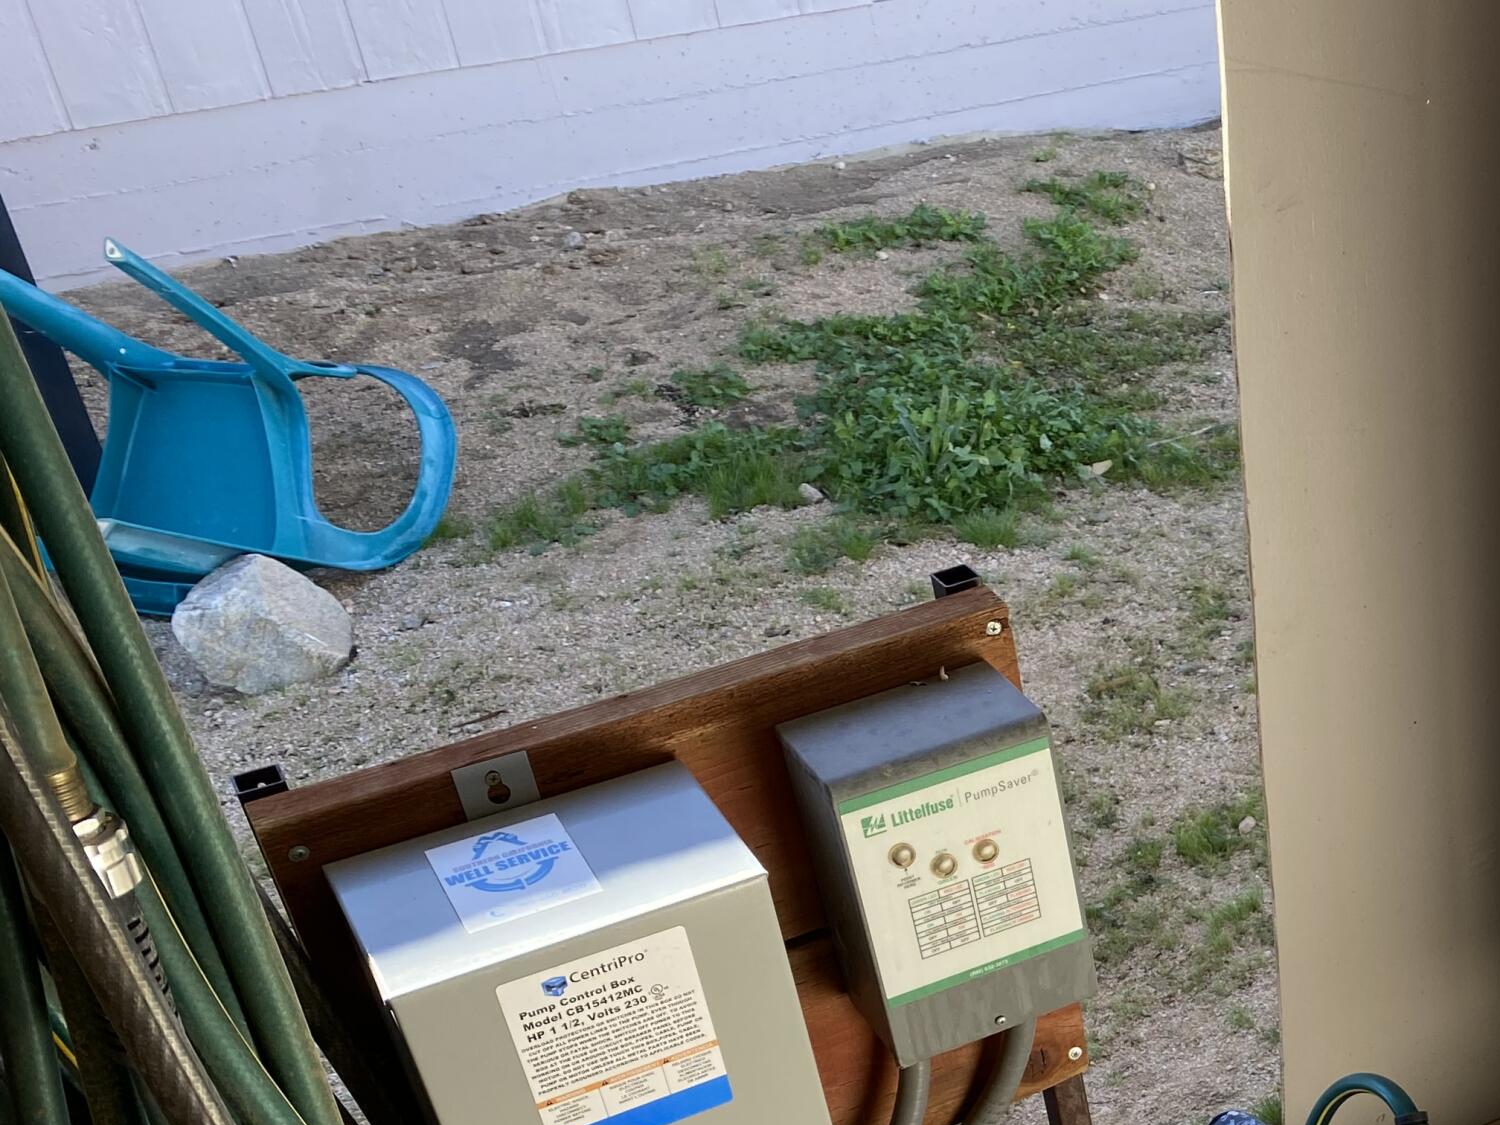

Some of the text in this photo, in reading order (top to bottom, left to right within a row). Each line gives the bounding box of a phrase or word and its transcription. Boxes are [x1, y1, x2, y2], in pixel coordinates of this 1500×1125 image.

[891, 774, 1031, 827] Littelfuse PumpSaver
[445, 841, 569, 886] WELL SERVICE
[569, 953, 645, 983] CentriPro
[519, 976, 635, 1021] Pump Control Box
[523, 985, 642, 1032] Model CB15412MC
[527, 995, 648, 1043] HP 1 1/2, Volts 230
